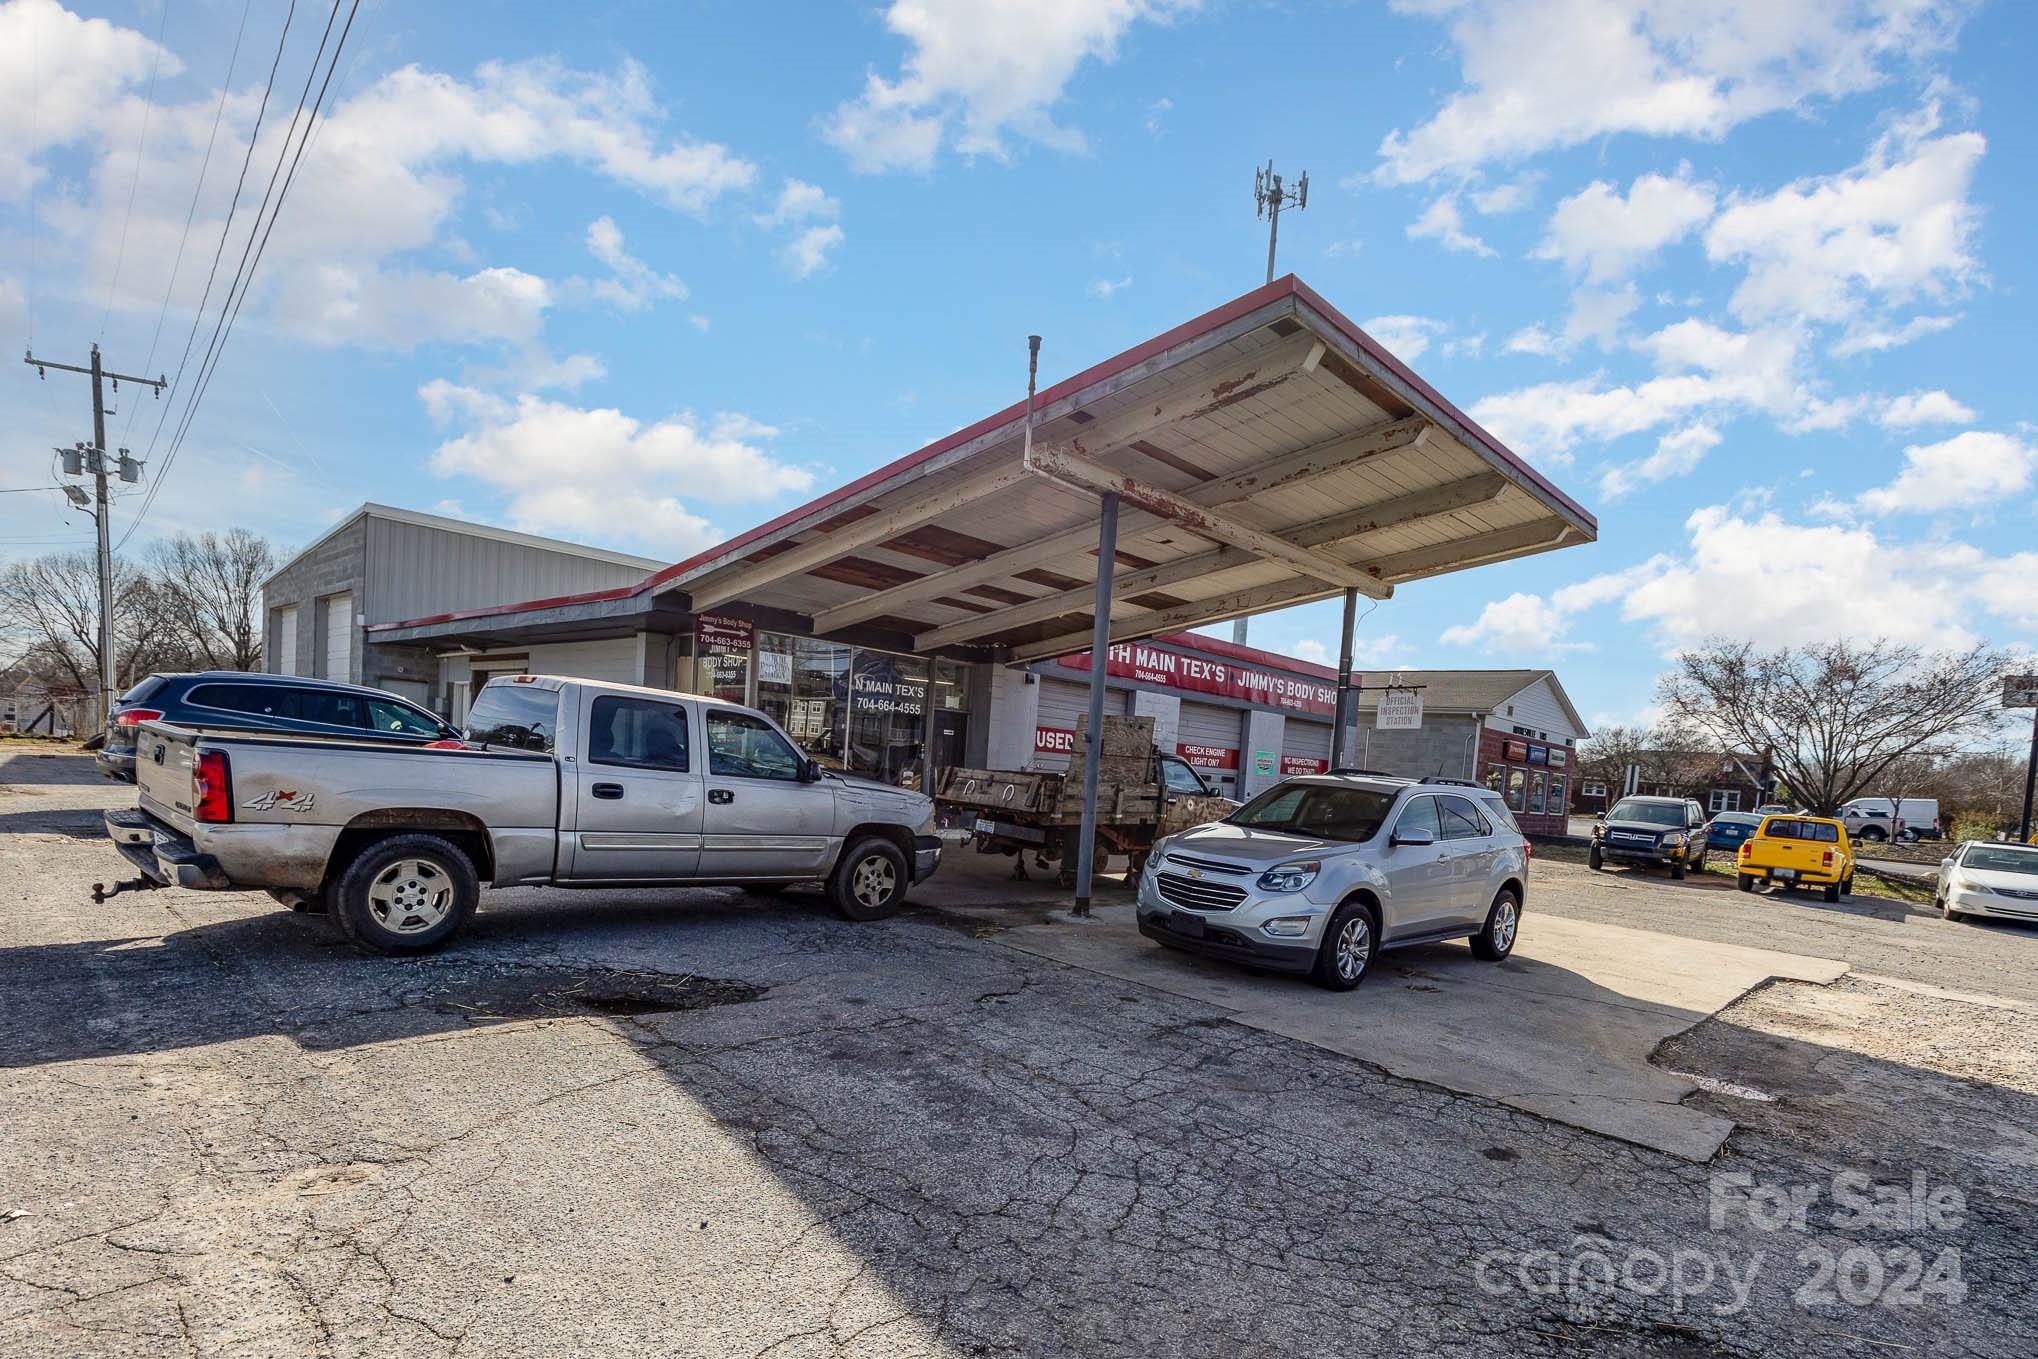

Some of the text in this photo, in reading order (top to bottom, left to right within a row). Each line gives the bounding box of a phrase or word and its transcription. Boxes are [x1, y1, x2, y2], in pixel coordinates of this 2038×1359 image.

[699, 614, 752, 629] Jimmy's Body Shop
[700, 635, 751, 648] 704-663-6355
[723, 656, 742, 667] SHOP
[1136, 648, 1175, 673] MAIN
[1181, 658, 1225, 682] TEX'S
[1135, 669, 1166, 684] 704-664-4555
[855, 679, 924, 698] N MAIN TEX'S
[1238, 671, 1337, 705] JIMMY'S BODY SHO
[857, 697, 921, 715] 704-664-4555
[1386, 695, 1415, 706] OFFICIAL
[1380, 705, 1419, 716] INSPECTION
[1386, 716, 1412, 726] STATION
[1036, 730, 1074, 750] USED
[1185, 745, 1226, 757] CHECK ENGINE
[1190, 756, 1220, 767] LIGHT ON?
[1291, 758, 1319, 767] INSPECTIONS
[1287, 766, 1295, 774] WE
[1295, 767, 1302, 775] DO
